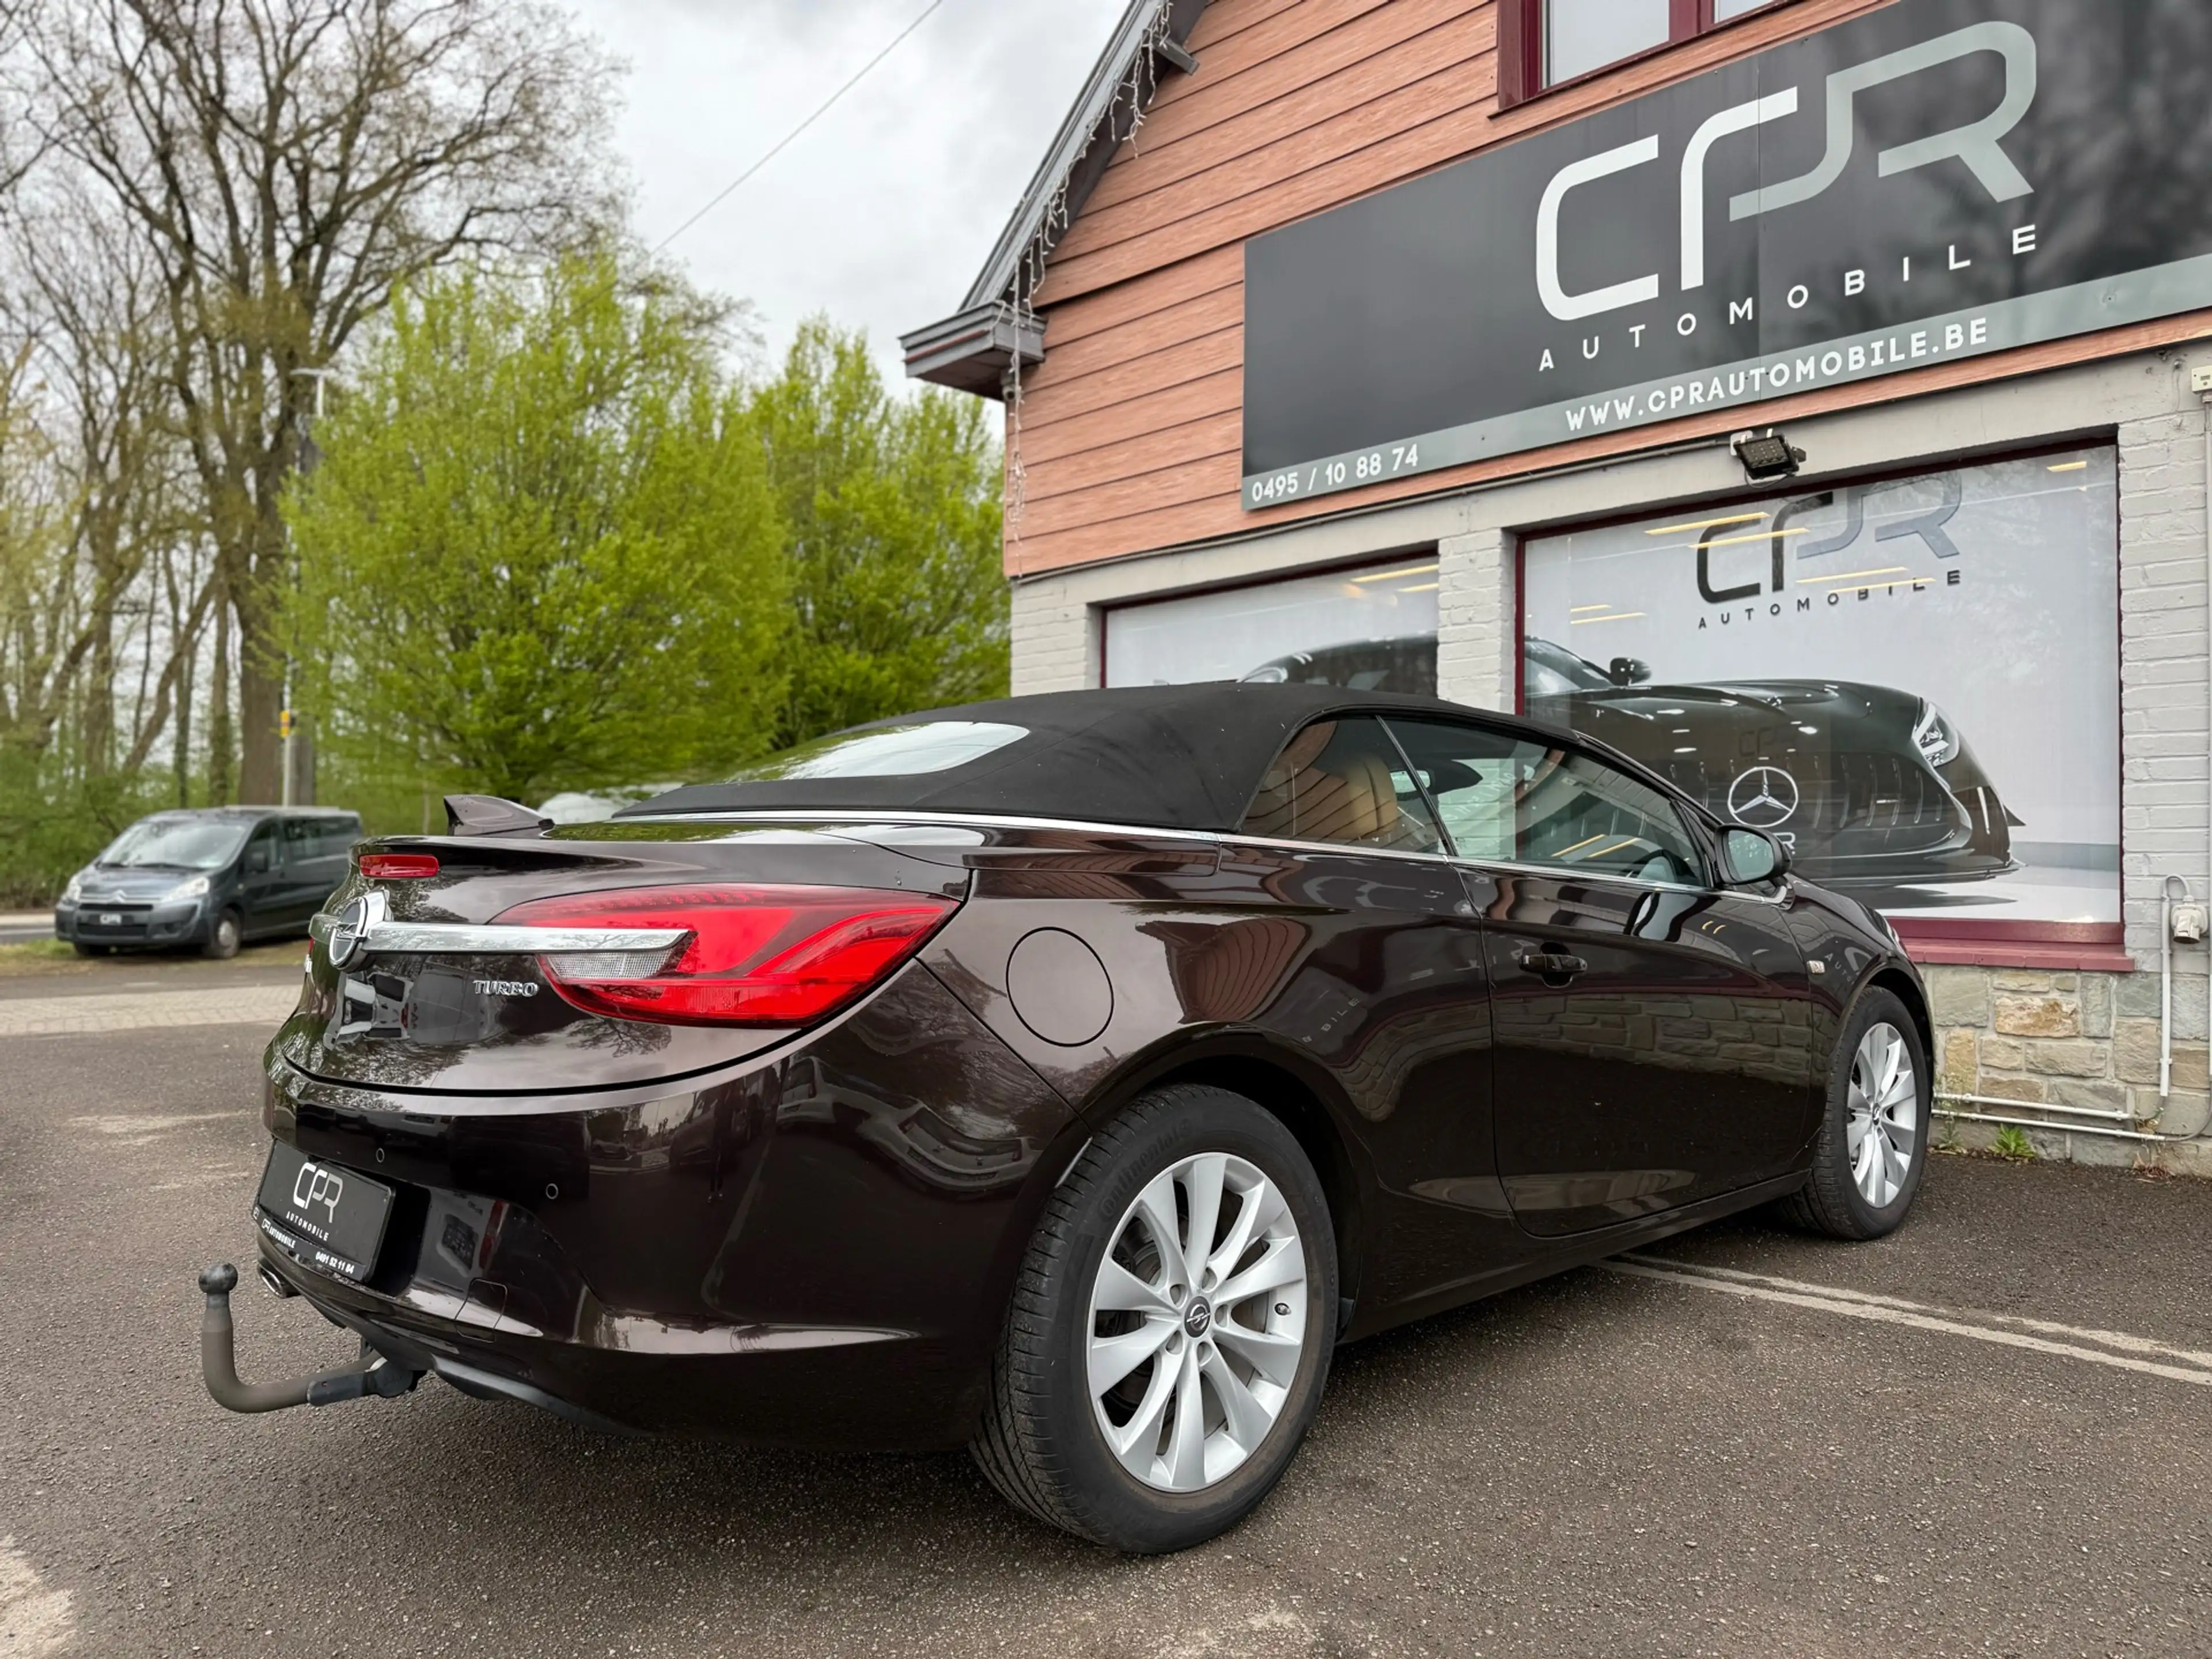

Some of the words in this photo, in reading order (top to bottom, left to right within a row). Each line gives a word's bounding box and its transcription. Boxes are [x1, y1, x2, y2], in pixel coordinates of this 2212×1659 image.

[1536, 21, 2037, 321] CPR
[1539, 225, 2036, 372] AUTOMOBILE
[1565, 317, 1987, 431] WWW.CPRAUTOMOBILE.BE
[1252, 471, 1298, 502] 0495
[1325, 462, 1346, 485] 10
[1356, 453, 1381, 479] 88
[1392, 443, 1418, 471] 74
[1696, 472, 1962, 604] CPR
[1699, 570, 1961, 629] AUTOMOBILE
[472, 980, 539, 997] TURBO
[293, 1162, 343, 1223] CPR
[286, 1211, 329, 1241] AUTOMOBILE
